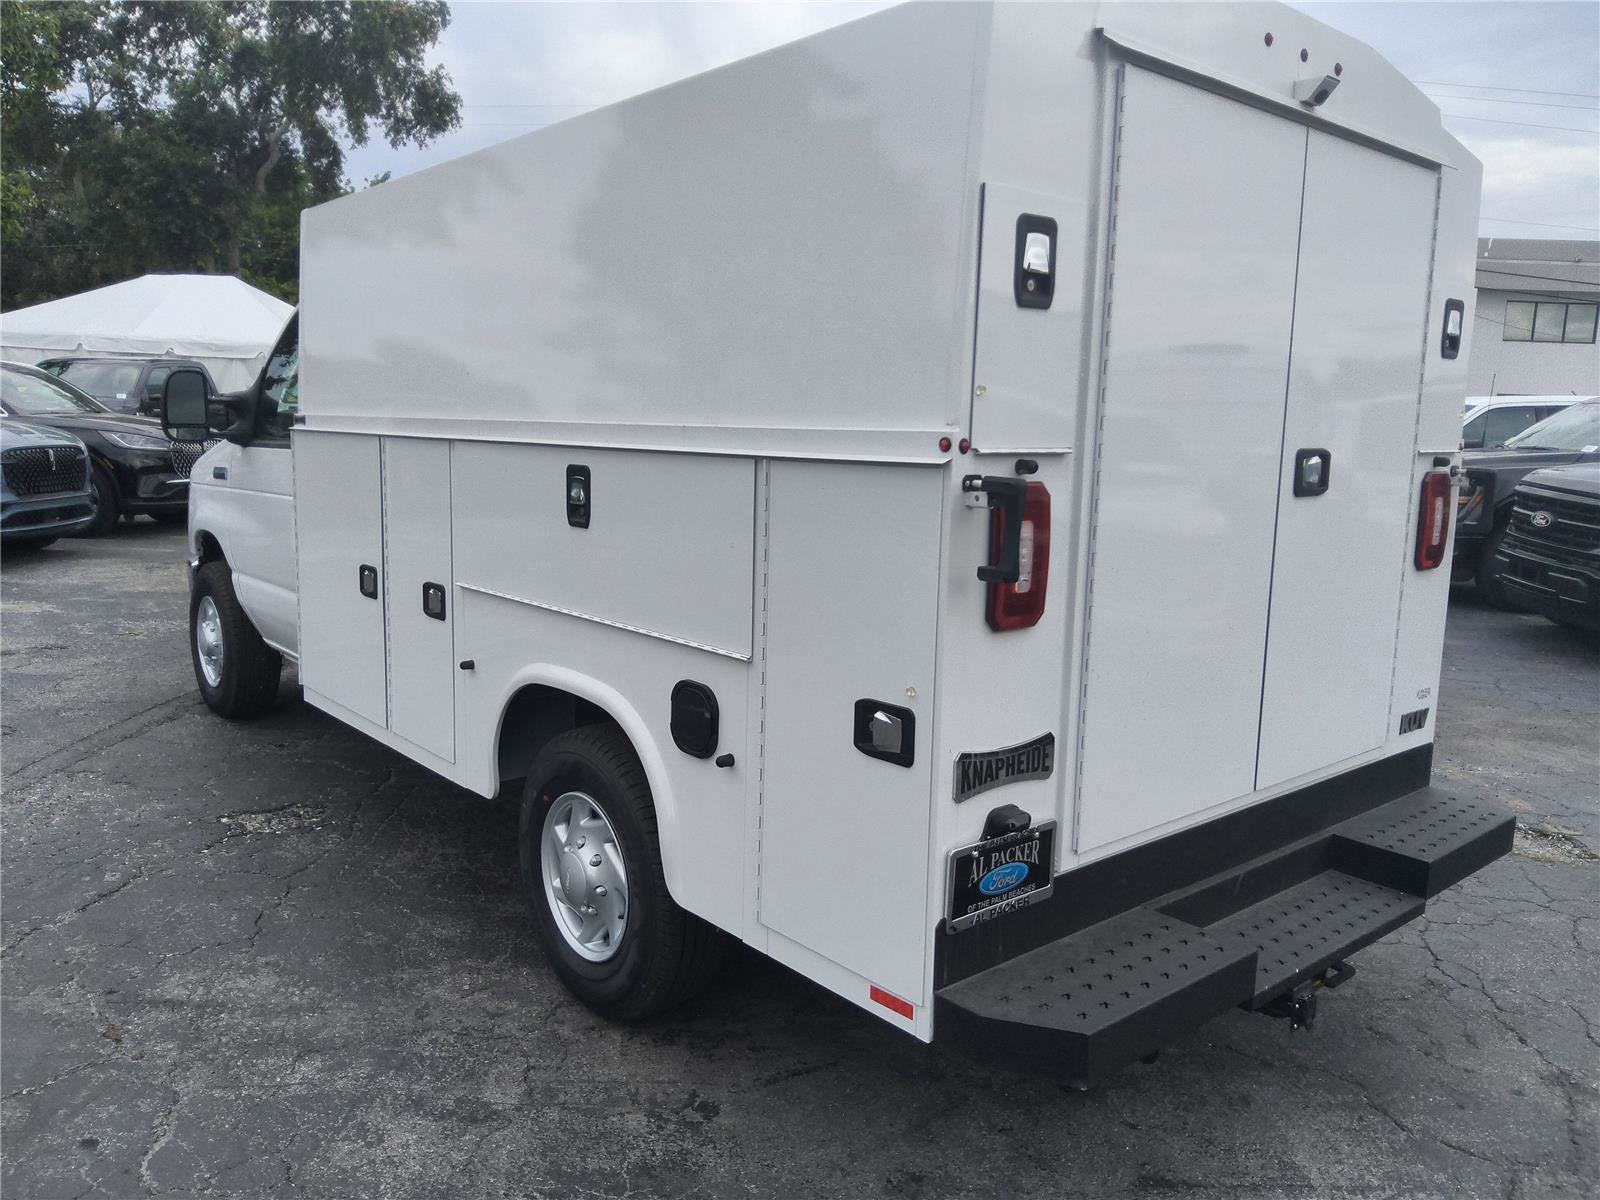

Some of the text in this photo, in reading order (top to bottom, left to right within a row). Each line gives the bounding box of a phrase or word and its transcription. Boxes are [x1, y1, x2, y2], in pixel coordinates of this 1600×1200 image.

[960, 745, 1050, 795] KNAPHEIDE
[968, 840, 1039, 888] AL PACKER
[989, 868, 1018, 891] Ford
[967, 883, 1036, 914] OF THE PALM BEACHES
[990, 896, 1030, 919] PACKER
